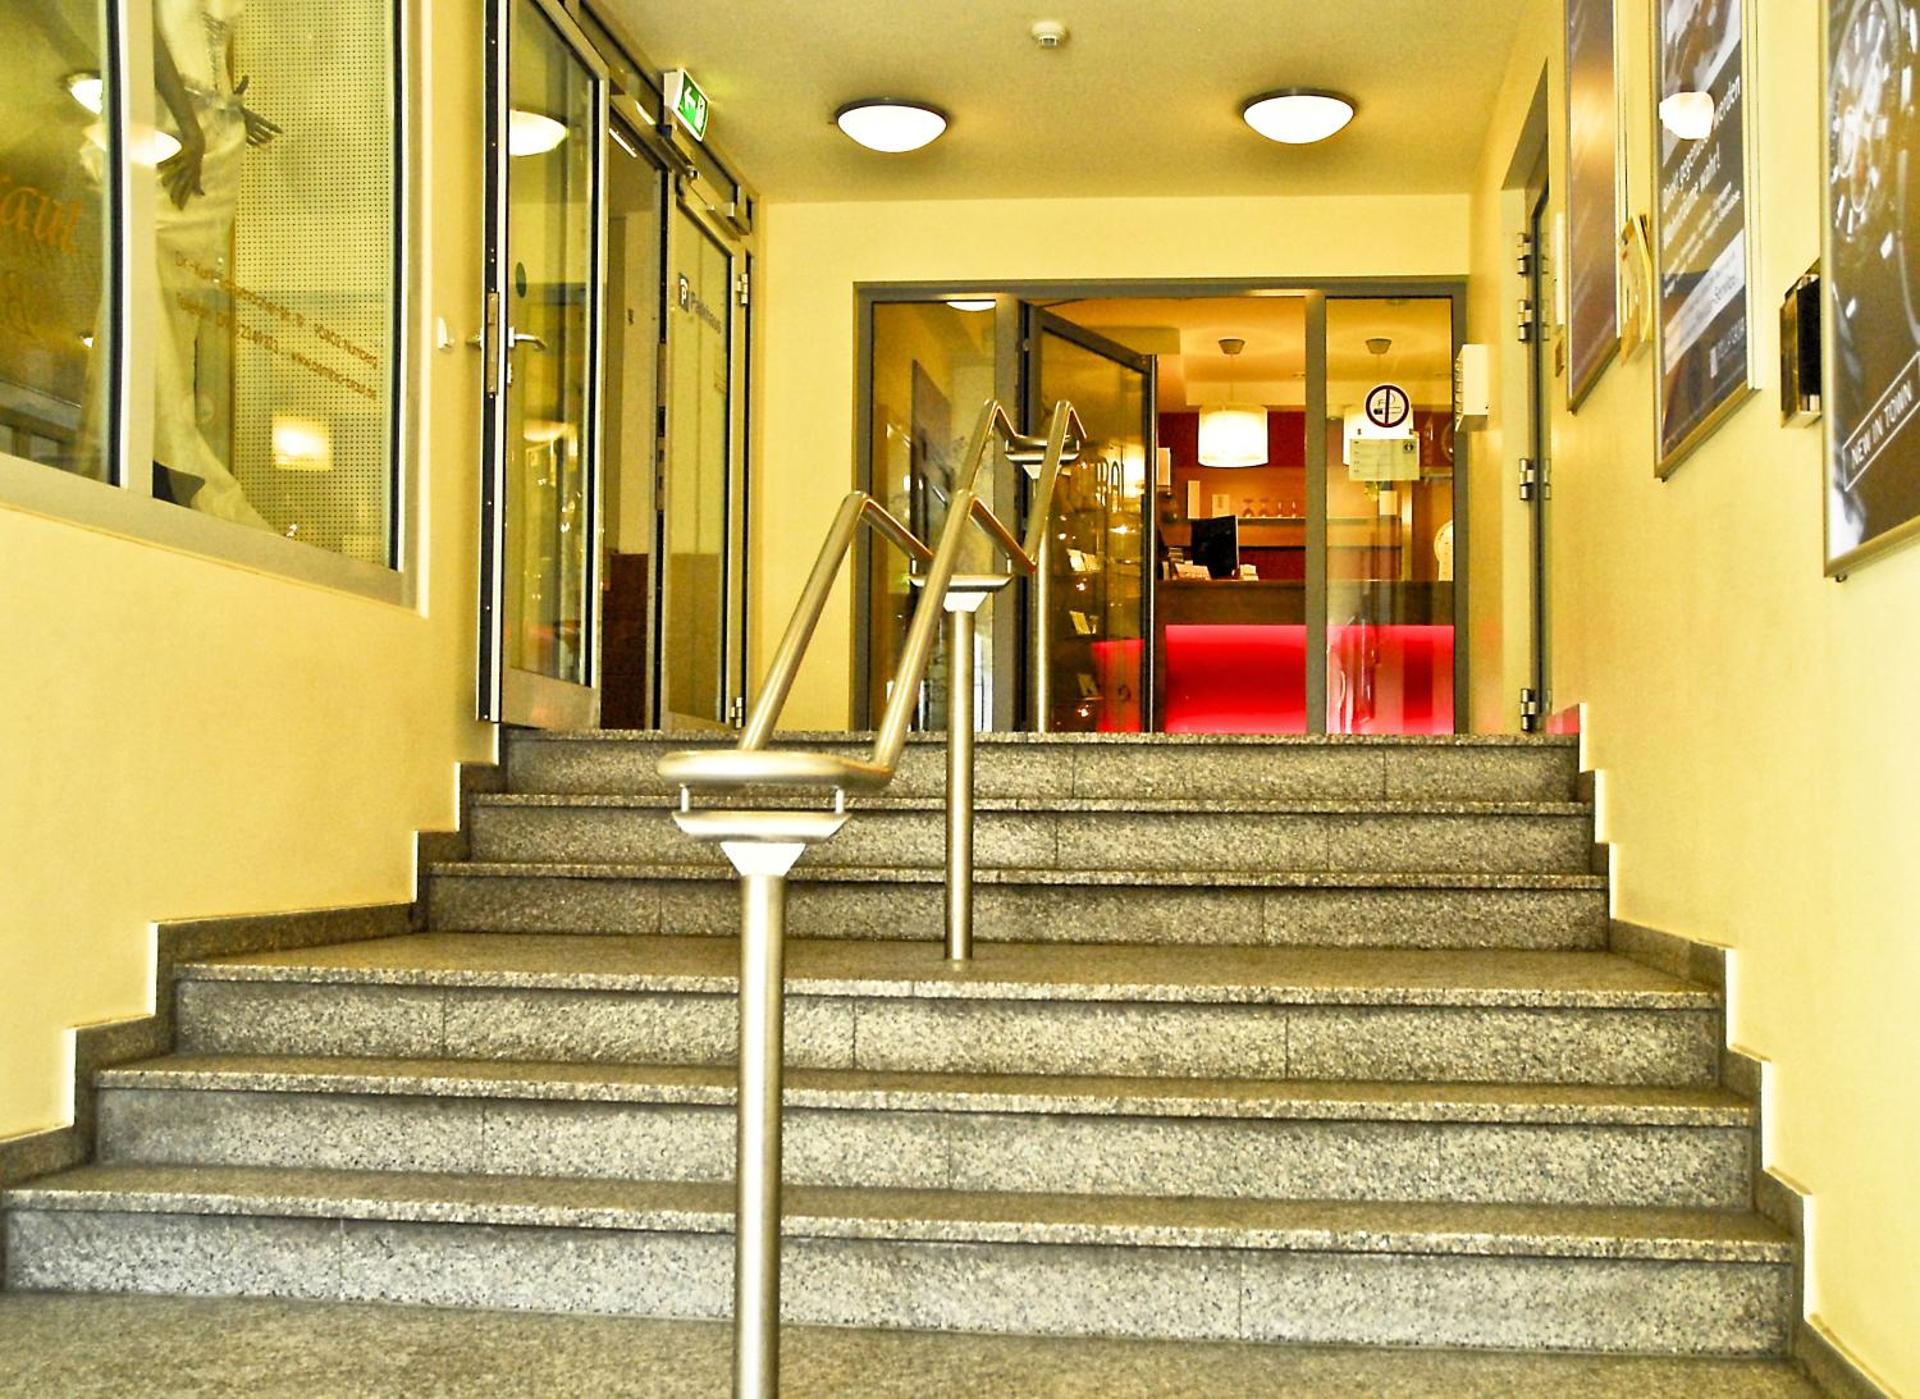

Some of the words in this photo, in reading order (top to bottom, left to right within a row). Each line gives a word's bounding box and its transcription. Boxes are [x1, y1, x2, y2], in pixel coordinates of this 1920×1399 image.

[1850, 428, 1872, 470] NEW
[1871, 414, 1884, 444] IN
[1883, 380, 1912, 428] TOWN
